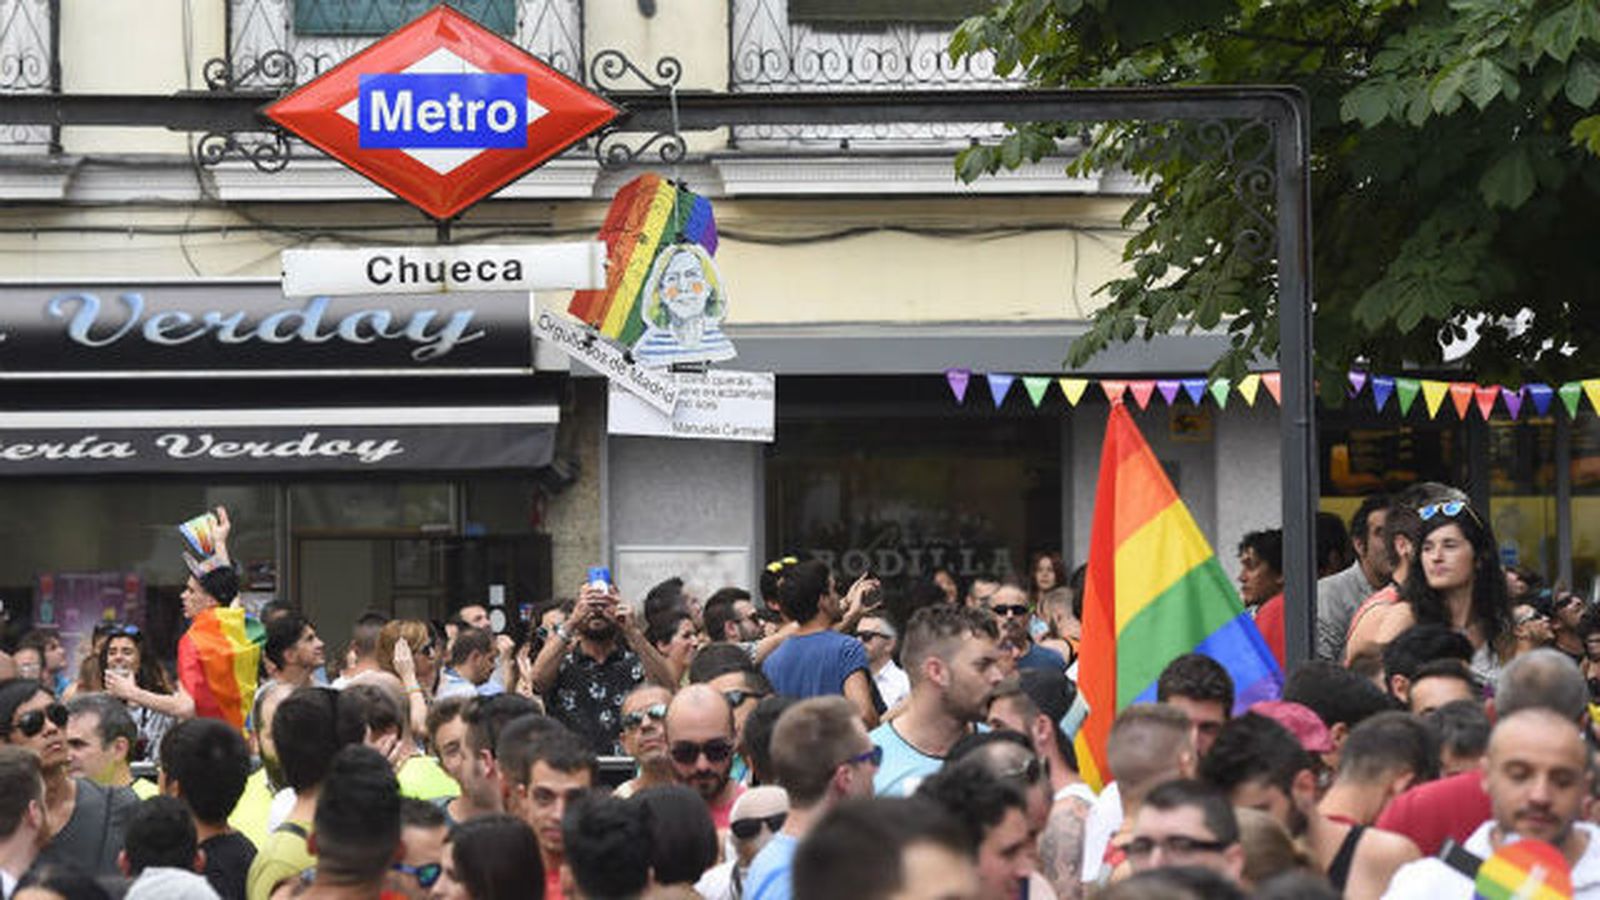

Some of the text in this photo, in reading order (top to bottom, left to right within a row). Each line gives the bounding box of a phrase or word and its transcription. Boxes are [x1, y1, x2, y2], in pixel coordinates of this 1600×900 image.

[370, 89, 517, 133] Metro
[366, 256, 523, 285] Chueca
[47, 291, 485, 361] Verdoy
[609, 357, 627, 376] de
[631, 366, 677, 404] Madrid
[156, 431, 403, 463] Verdoy
